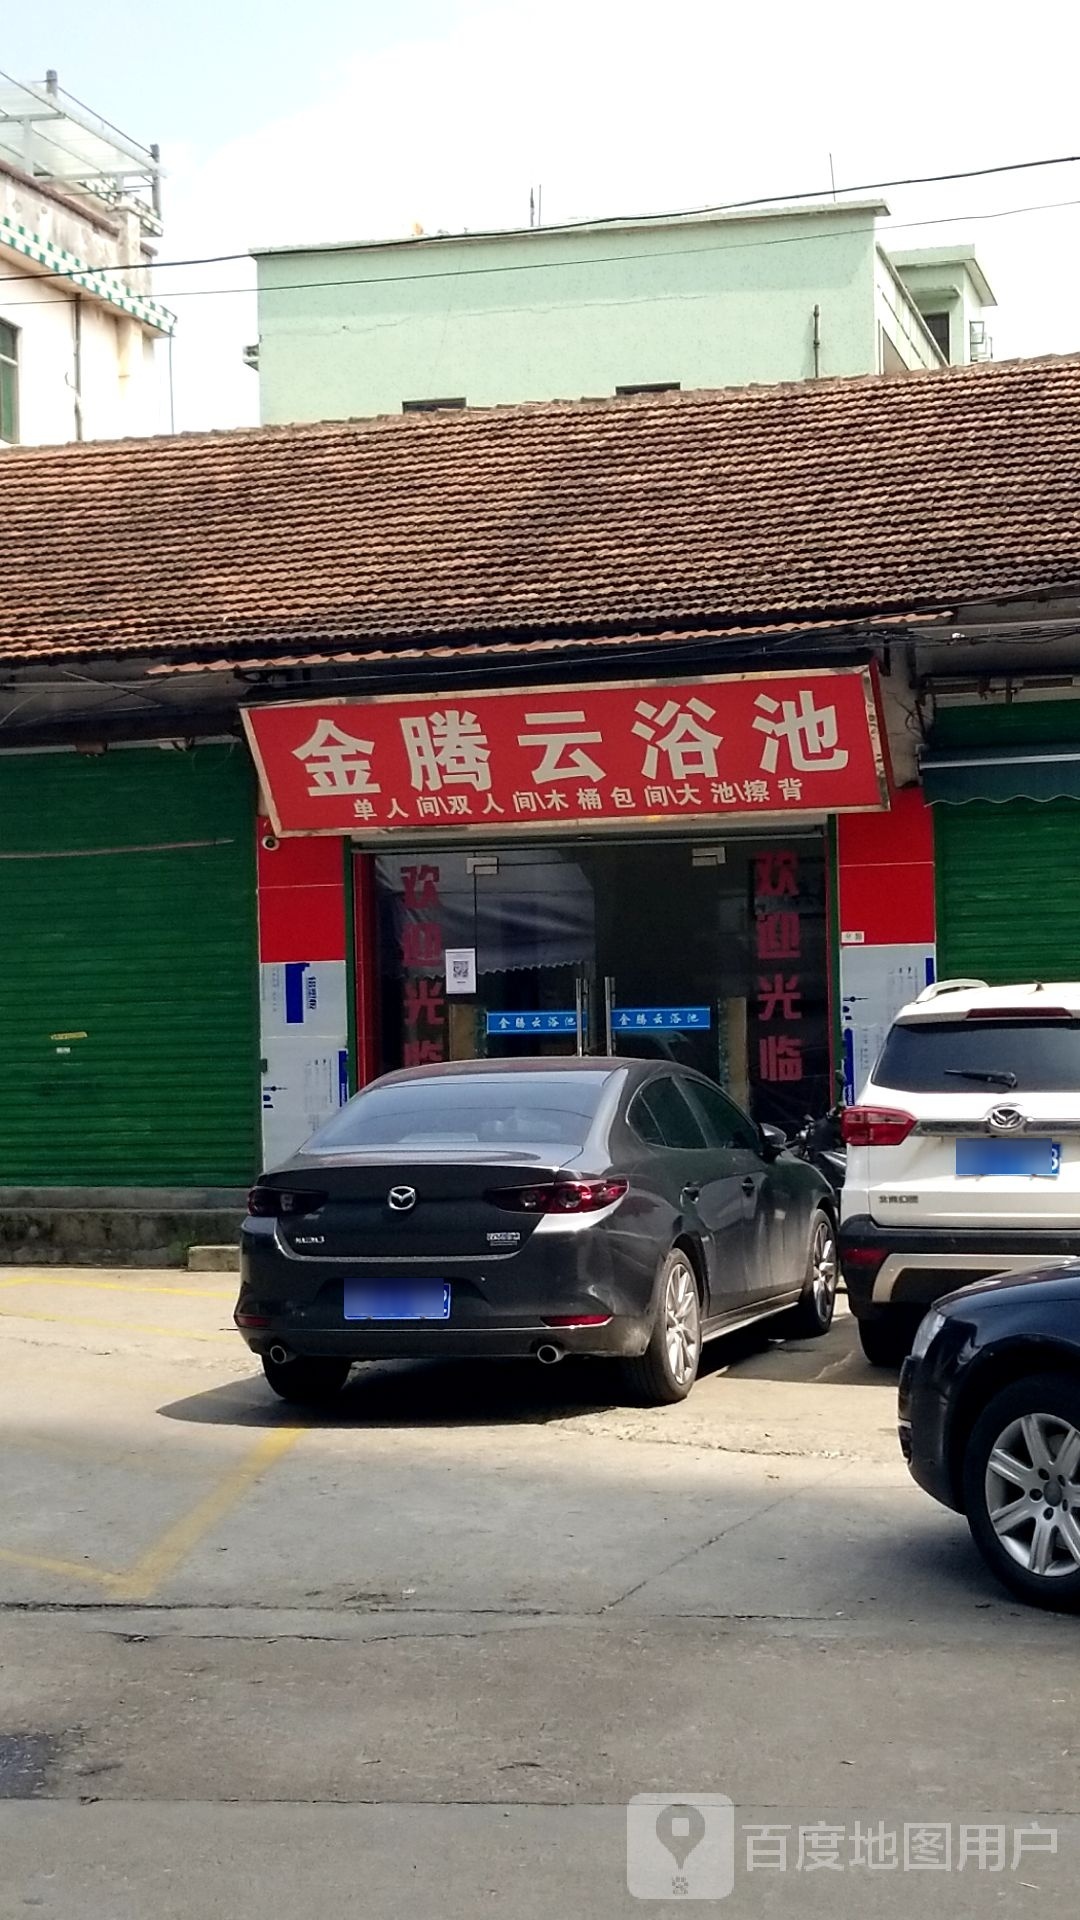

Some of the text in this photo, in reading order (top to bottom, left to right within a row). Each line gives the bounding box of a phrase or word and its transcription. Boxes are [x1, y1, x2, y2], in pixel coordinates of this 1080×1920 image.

[292, 690, 849, 797] 金腾云浴池
[754, 851, 803, 1082] 欢迎光临
